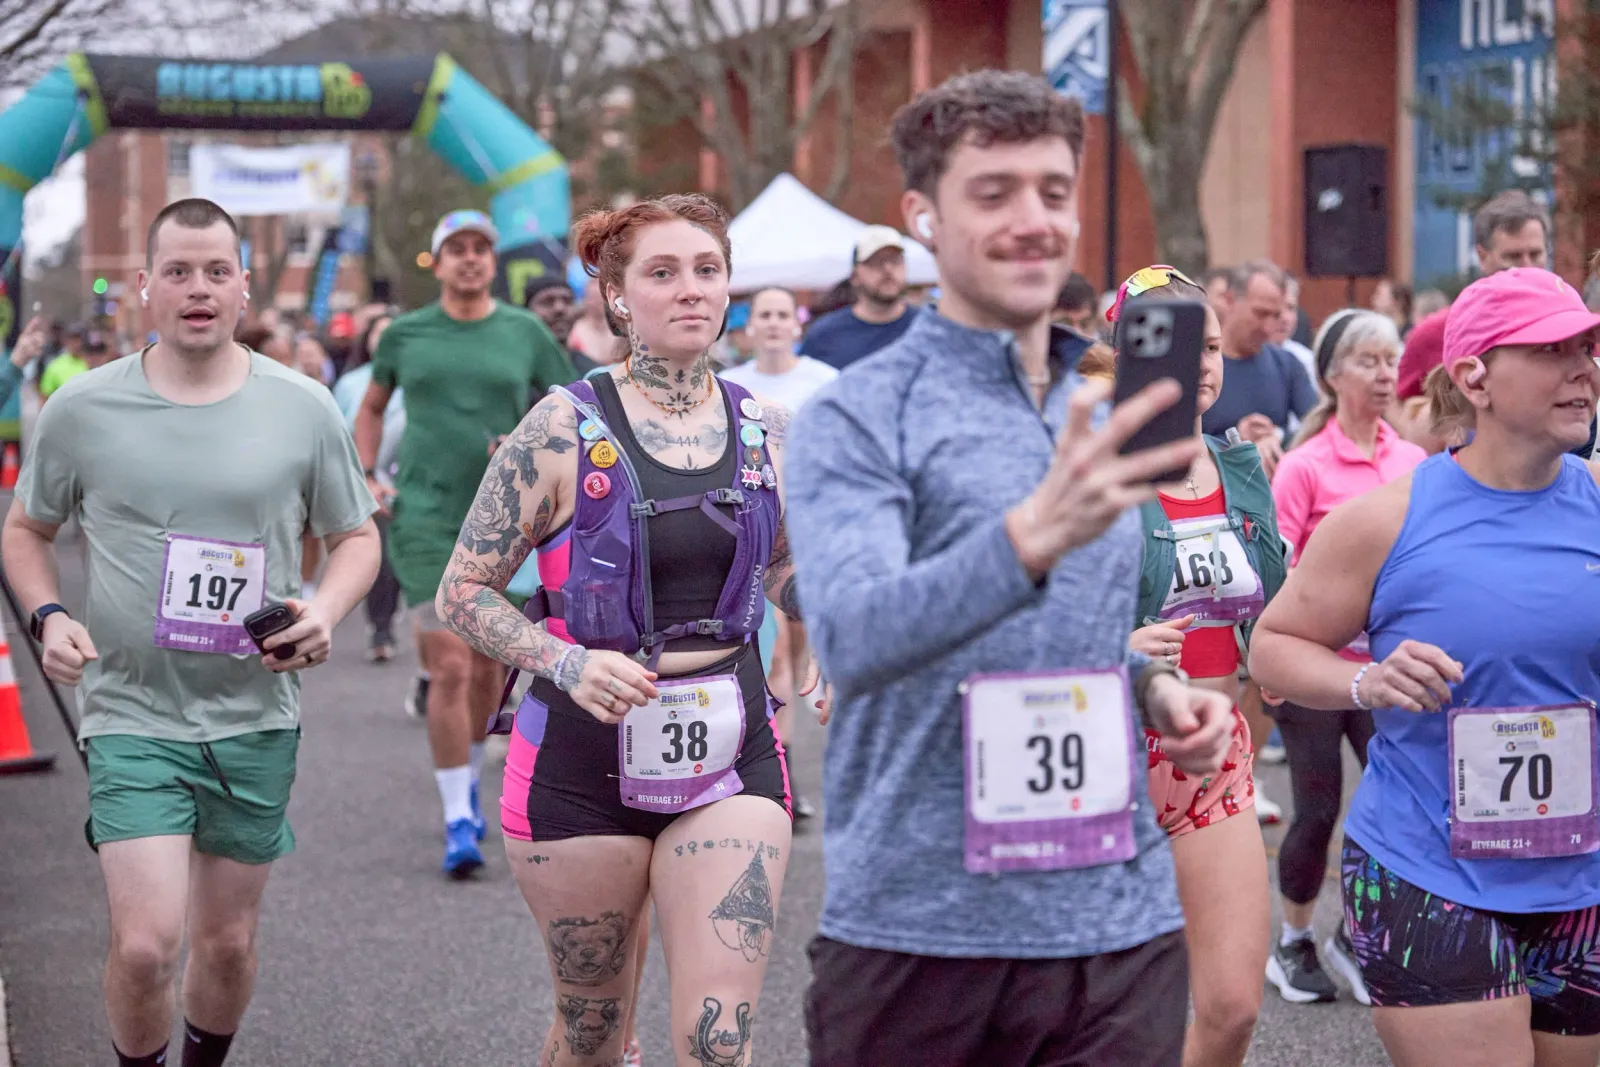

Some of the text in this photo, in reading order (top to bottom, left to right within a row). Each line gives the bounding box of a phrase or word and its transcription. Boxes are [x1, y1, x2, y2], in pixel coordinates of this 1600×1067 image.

[157, 63, 322, 102] AUGUSTA
[1173, 550, 1233, 594] 168
[186, 573, 248, 611] 197
[743, 564, 763, 628] NATHAN
[169, 633, 199, 644] BEVERAGE
[661, 692, 696, 704] AUGUSTA
[1497, 721, 1539, 733] AUGUSTA
[661, 720, 708, 764] 38
[1026, 733, 1086, 794] 39
[715, 782, 725, 792] 38
[1498, 753, 1552, 803] 70
[638, 794, 672, 805] BEVERAGE
[1472, 839, 1511, 850] BEVERAGE
[1571, 834, 1582, 844] 70
